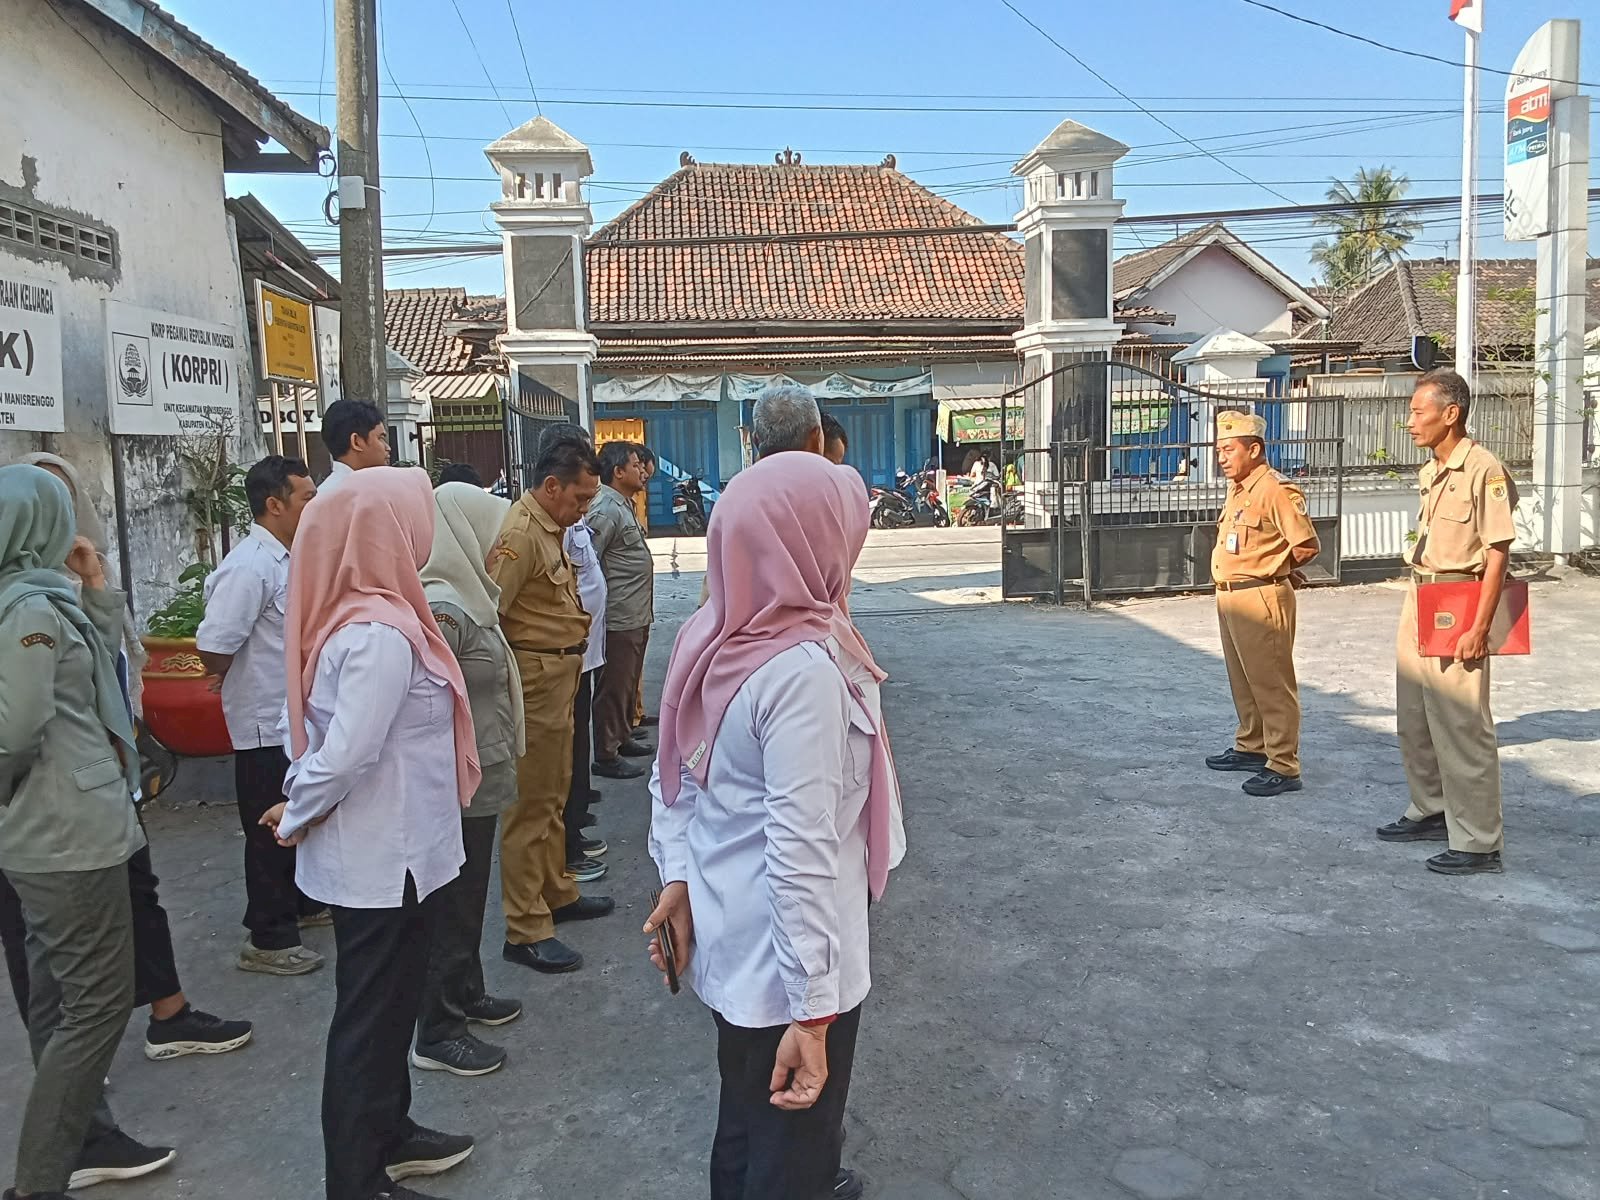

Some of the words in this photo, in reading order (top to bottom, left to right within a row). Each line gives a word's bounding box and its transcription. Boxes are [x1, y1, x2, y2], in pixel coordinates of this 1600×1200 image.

[1521, 93, 1547, 114] atm
[20, 283, 54, 315] KELUARGA
[151, 321, 165, 338] KORP
[166, 324, 189, 342] PEGAWAI
[189, 327, 212, 346] REPUBLIK
[212, 332, 234, 350] INDONESIA
[4, 392, 55, 408] MANISRENGGO
[163, 402, 175, 413] UNIT
[175, 403, 203, 414] KECAMATAN
[0, 411, 15, 425] TEN
